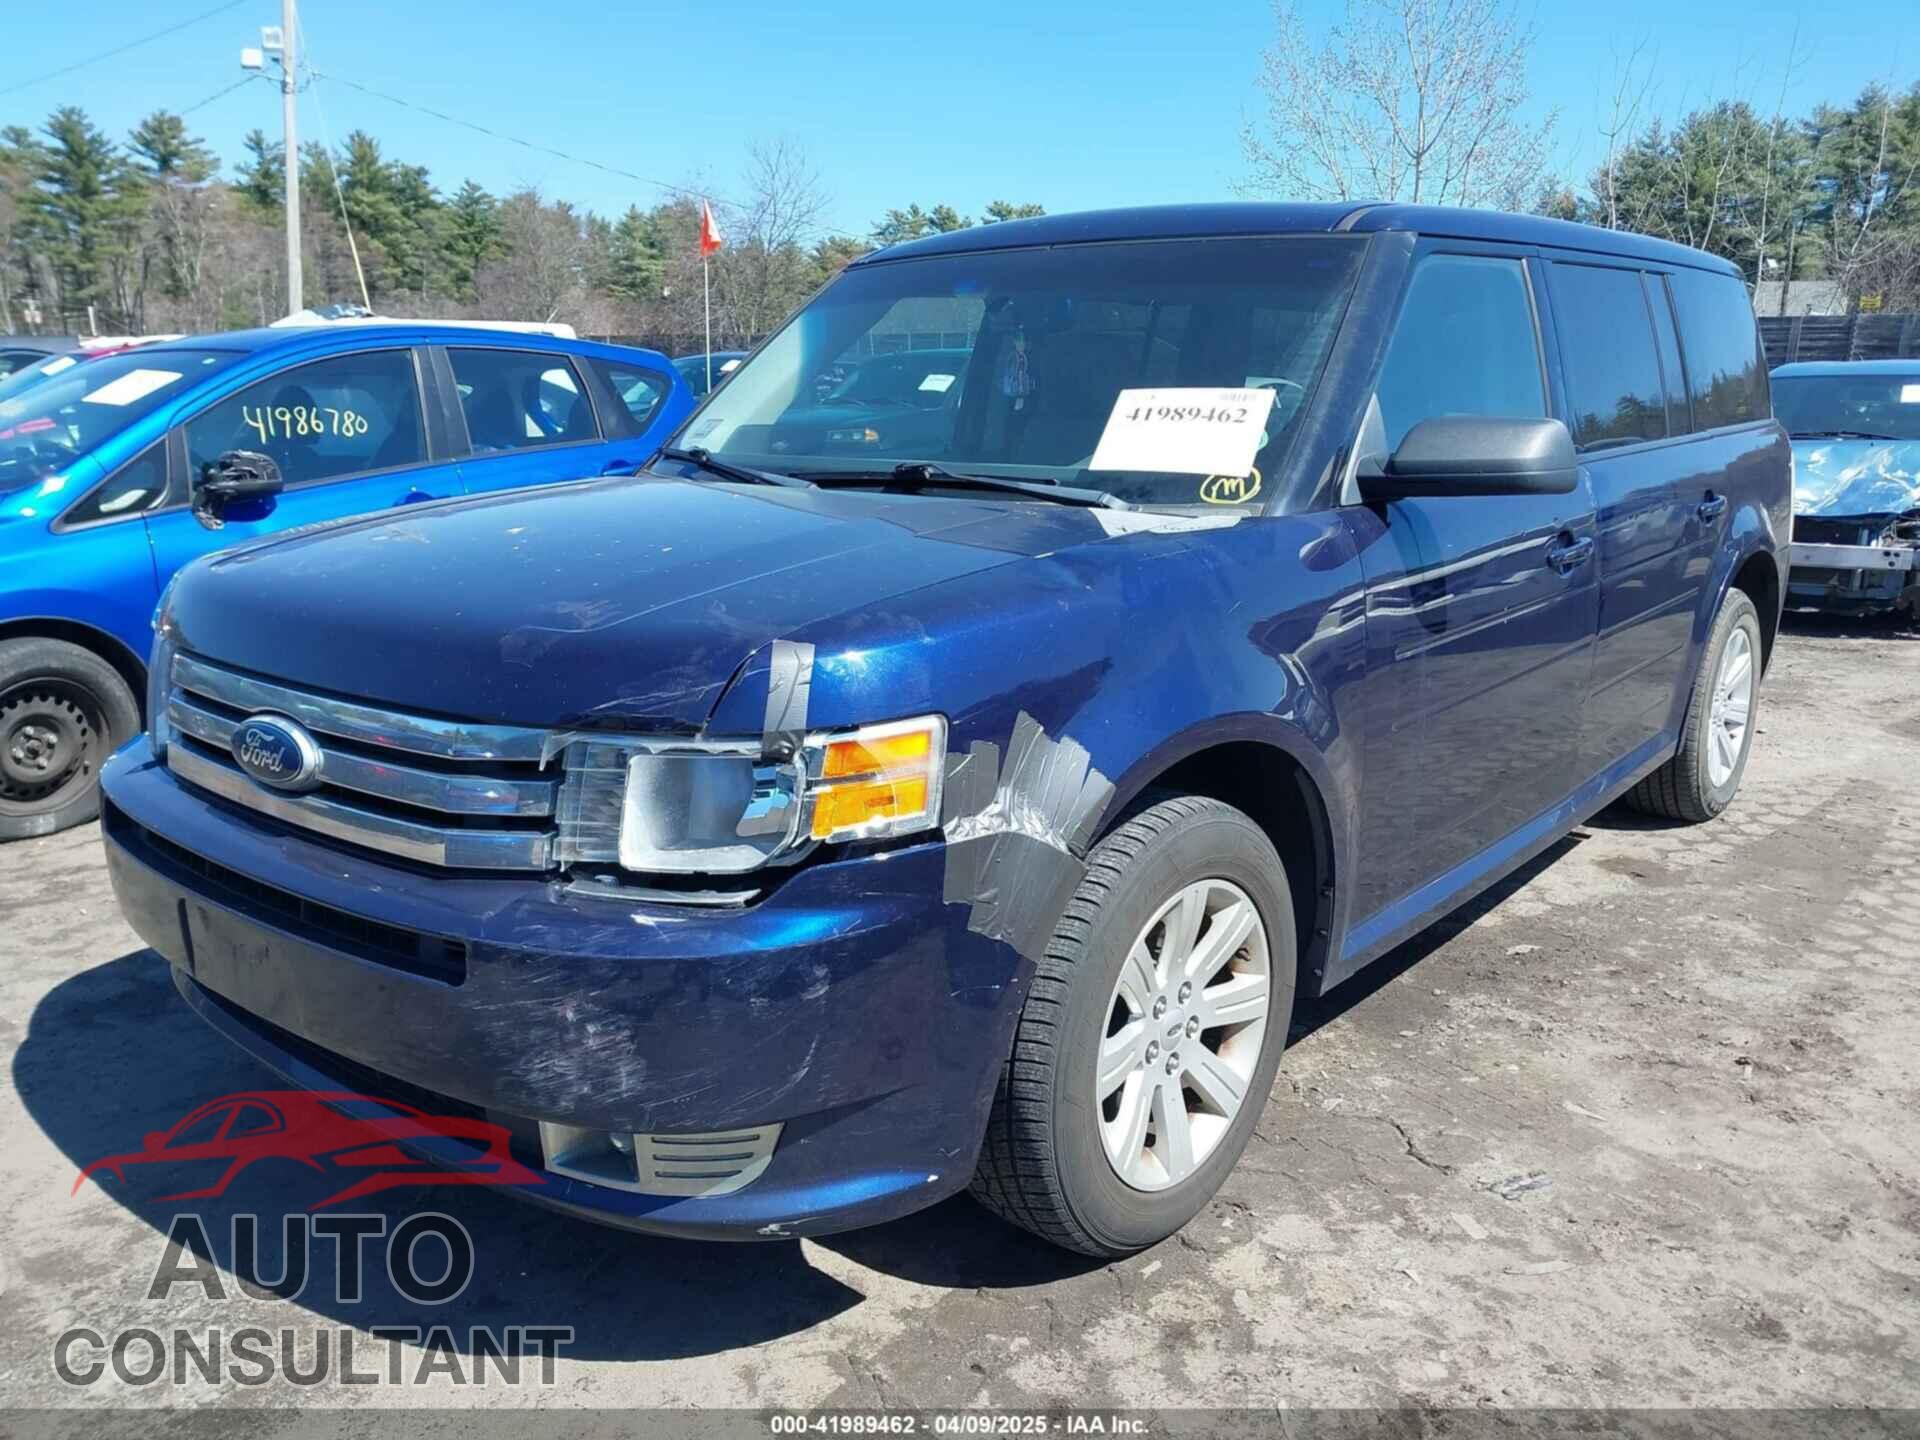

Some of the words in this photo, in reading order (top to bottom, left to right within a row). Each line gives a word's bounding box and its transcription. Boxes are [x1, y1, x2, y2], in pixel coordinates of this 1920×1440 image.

[242, 405, 369, 445] 41986780
[1125, 406, 1249, 424] 41989462
[240, 727, 287, 773] Ford
